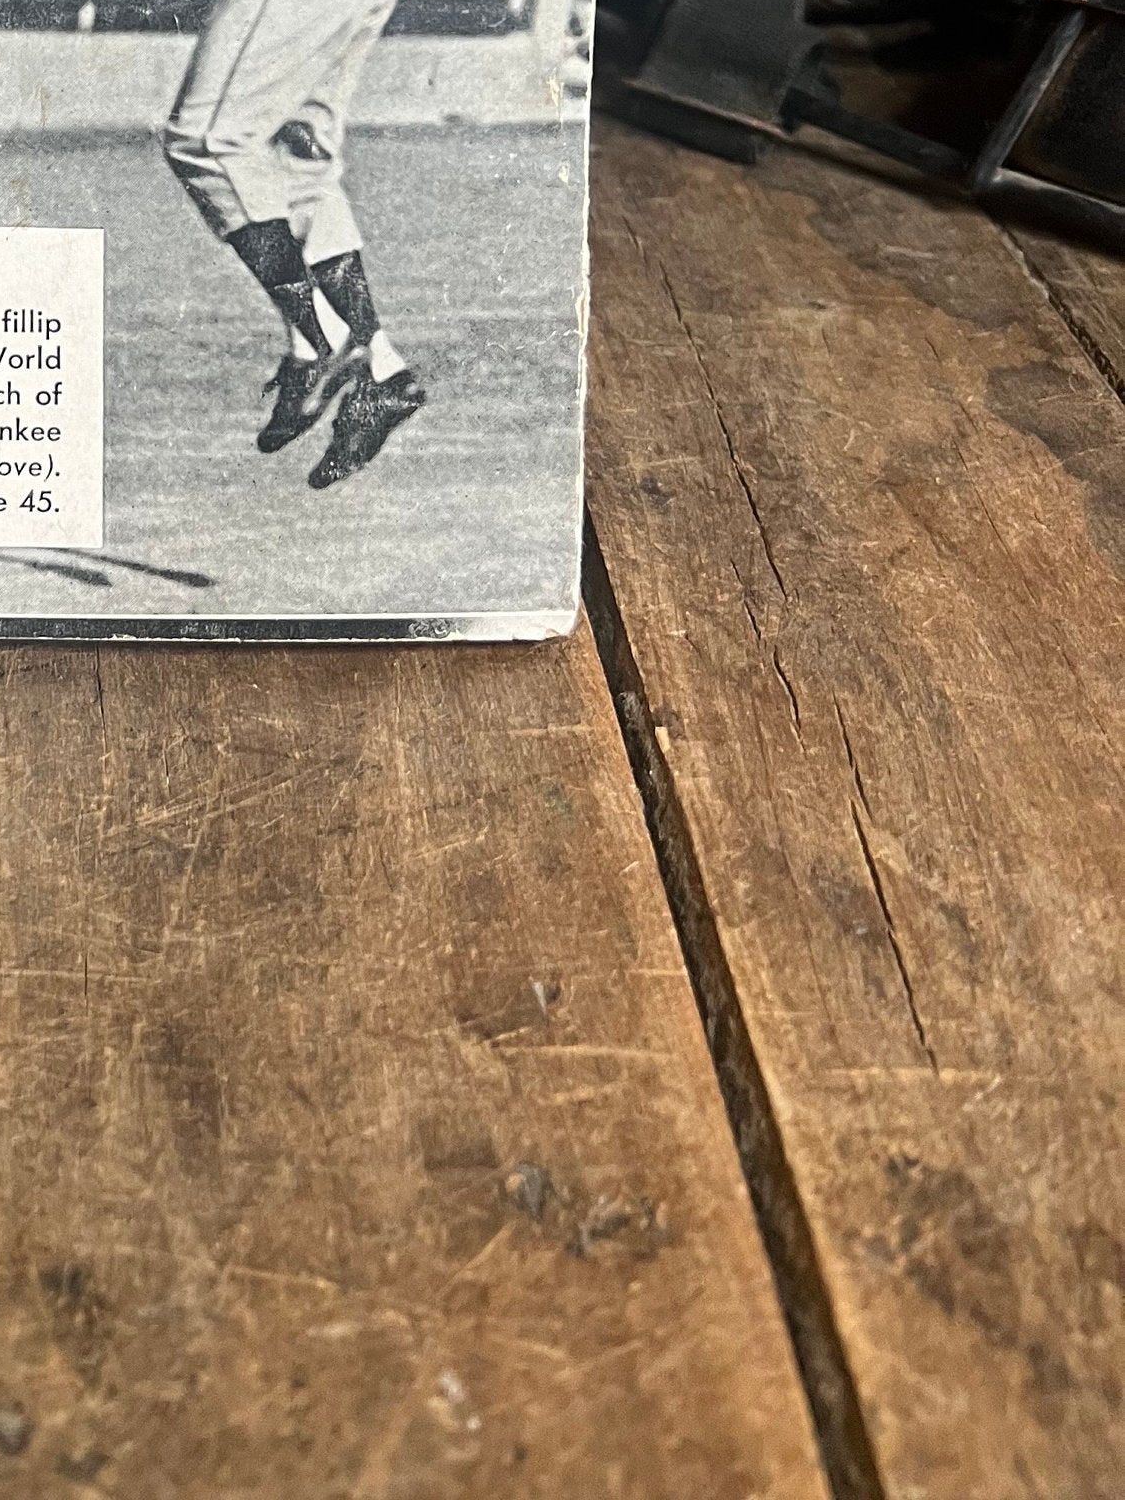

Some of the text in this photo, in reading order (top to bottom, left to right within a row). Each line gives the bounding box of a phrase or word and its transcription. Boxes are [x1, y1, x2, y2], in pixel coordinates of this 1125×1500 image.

[1, 308, 62, 338] fillip
[35, 381, 63, 406] of
[19, 489, 60, 513] 45.
